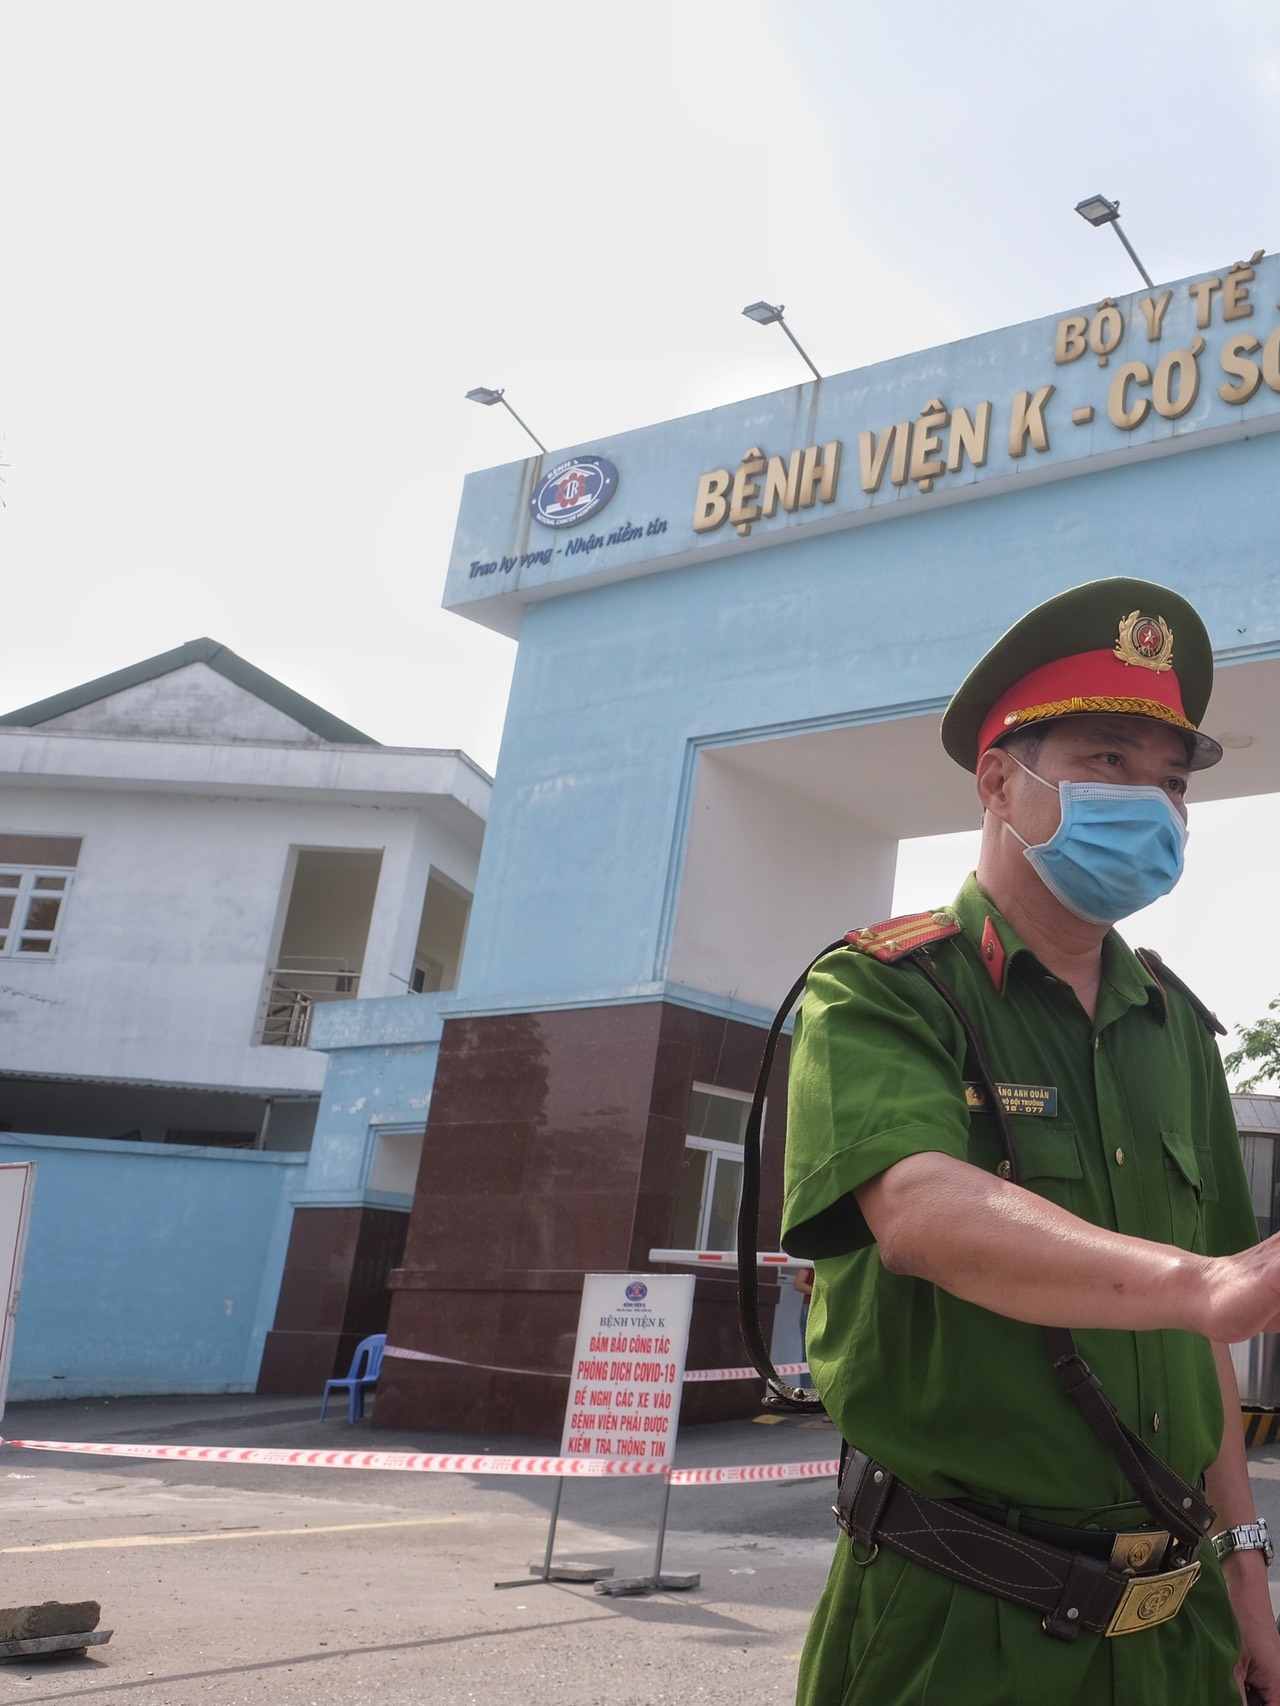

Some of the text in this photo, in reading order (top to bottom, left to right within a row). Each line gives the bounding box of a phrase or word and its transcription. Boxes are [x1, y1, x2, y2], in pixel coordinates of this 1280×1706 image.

[1055, 249, 1266, 367] BỘ Y TẾ
[693, 446, 843, 537] BỆNH
[857, 397, 993, 494] VIỆN
[1008, 384, 1056, 453] K
[1107, 335, 1206, 431] CƠ
[469, 561, 498, 580] Trao
[519, 547, 554, 570] vọng
[564, 534, 604, 557] Nhận
[606, 521, 643, 546] niềm
[646, 517, 668, 538] tín
[1013, 1089, 1028, 1098] ANH
[1029, 1088, 1050, 1099] QUÂN
[1025, 1106, 1044, 1114] 077
[599, 1314, 666, 1330] BỆNH VIỆN K
[589, 1331, 671, 1354] ĐẢM BẢO CÔNG TÁC
[576, 1356, 676, 1386] PHÒNG DỊCH COVID-19
[589, 1390, 613, 1410] NGHỊ
[615, 1388, 634, 1408] CÁC
[637, 1391, 649, 1408] XE
[653, 1389, 671, 1409] VÀO
[571, 1410, 669, 1436] BỆNH VIỆN PHẢI ĐƯỢC
[567, 1430, 666, 1458] KIỂM TRA THÔNG TIN
